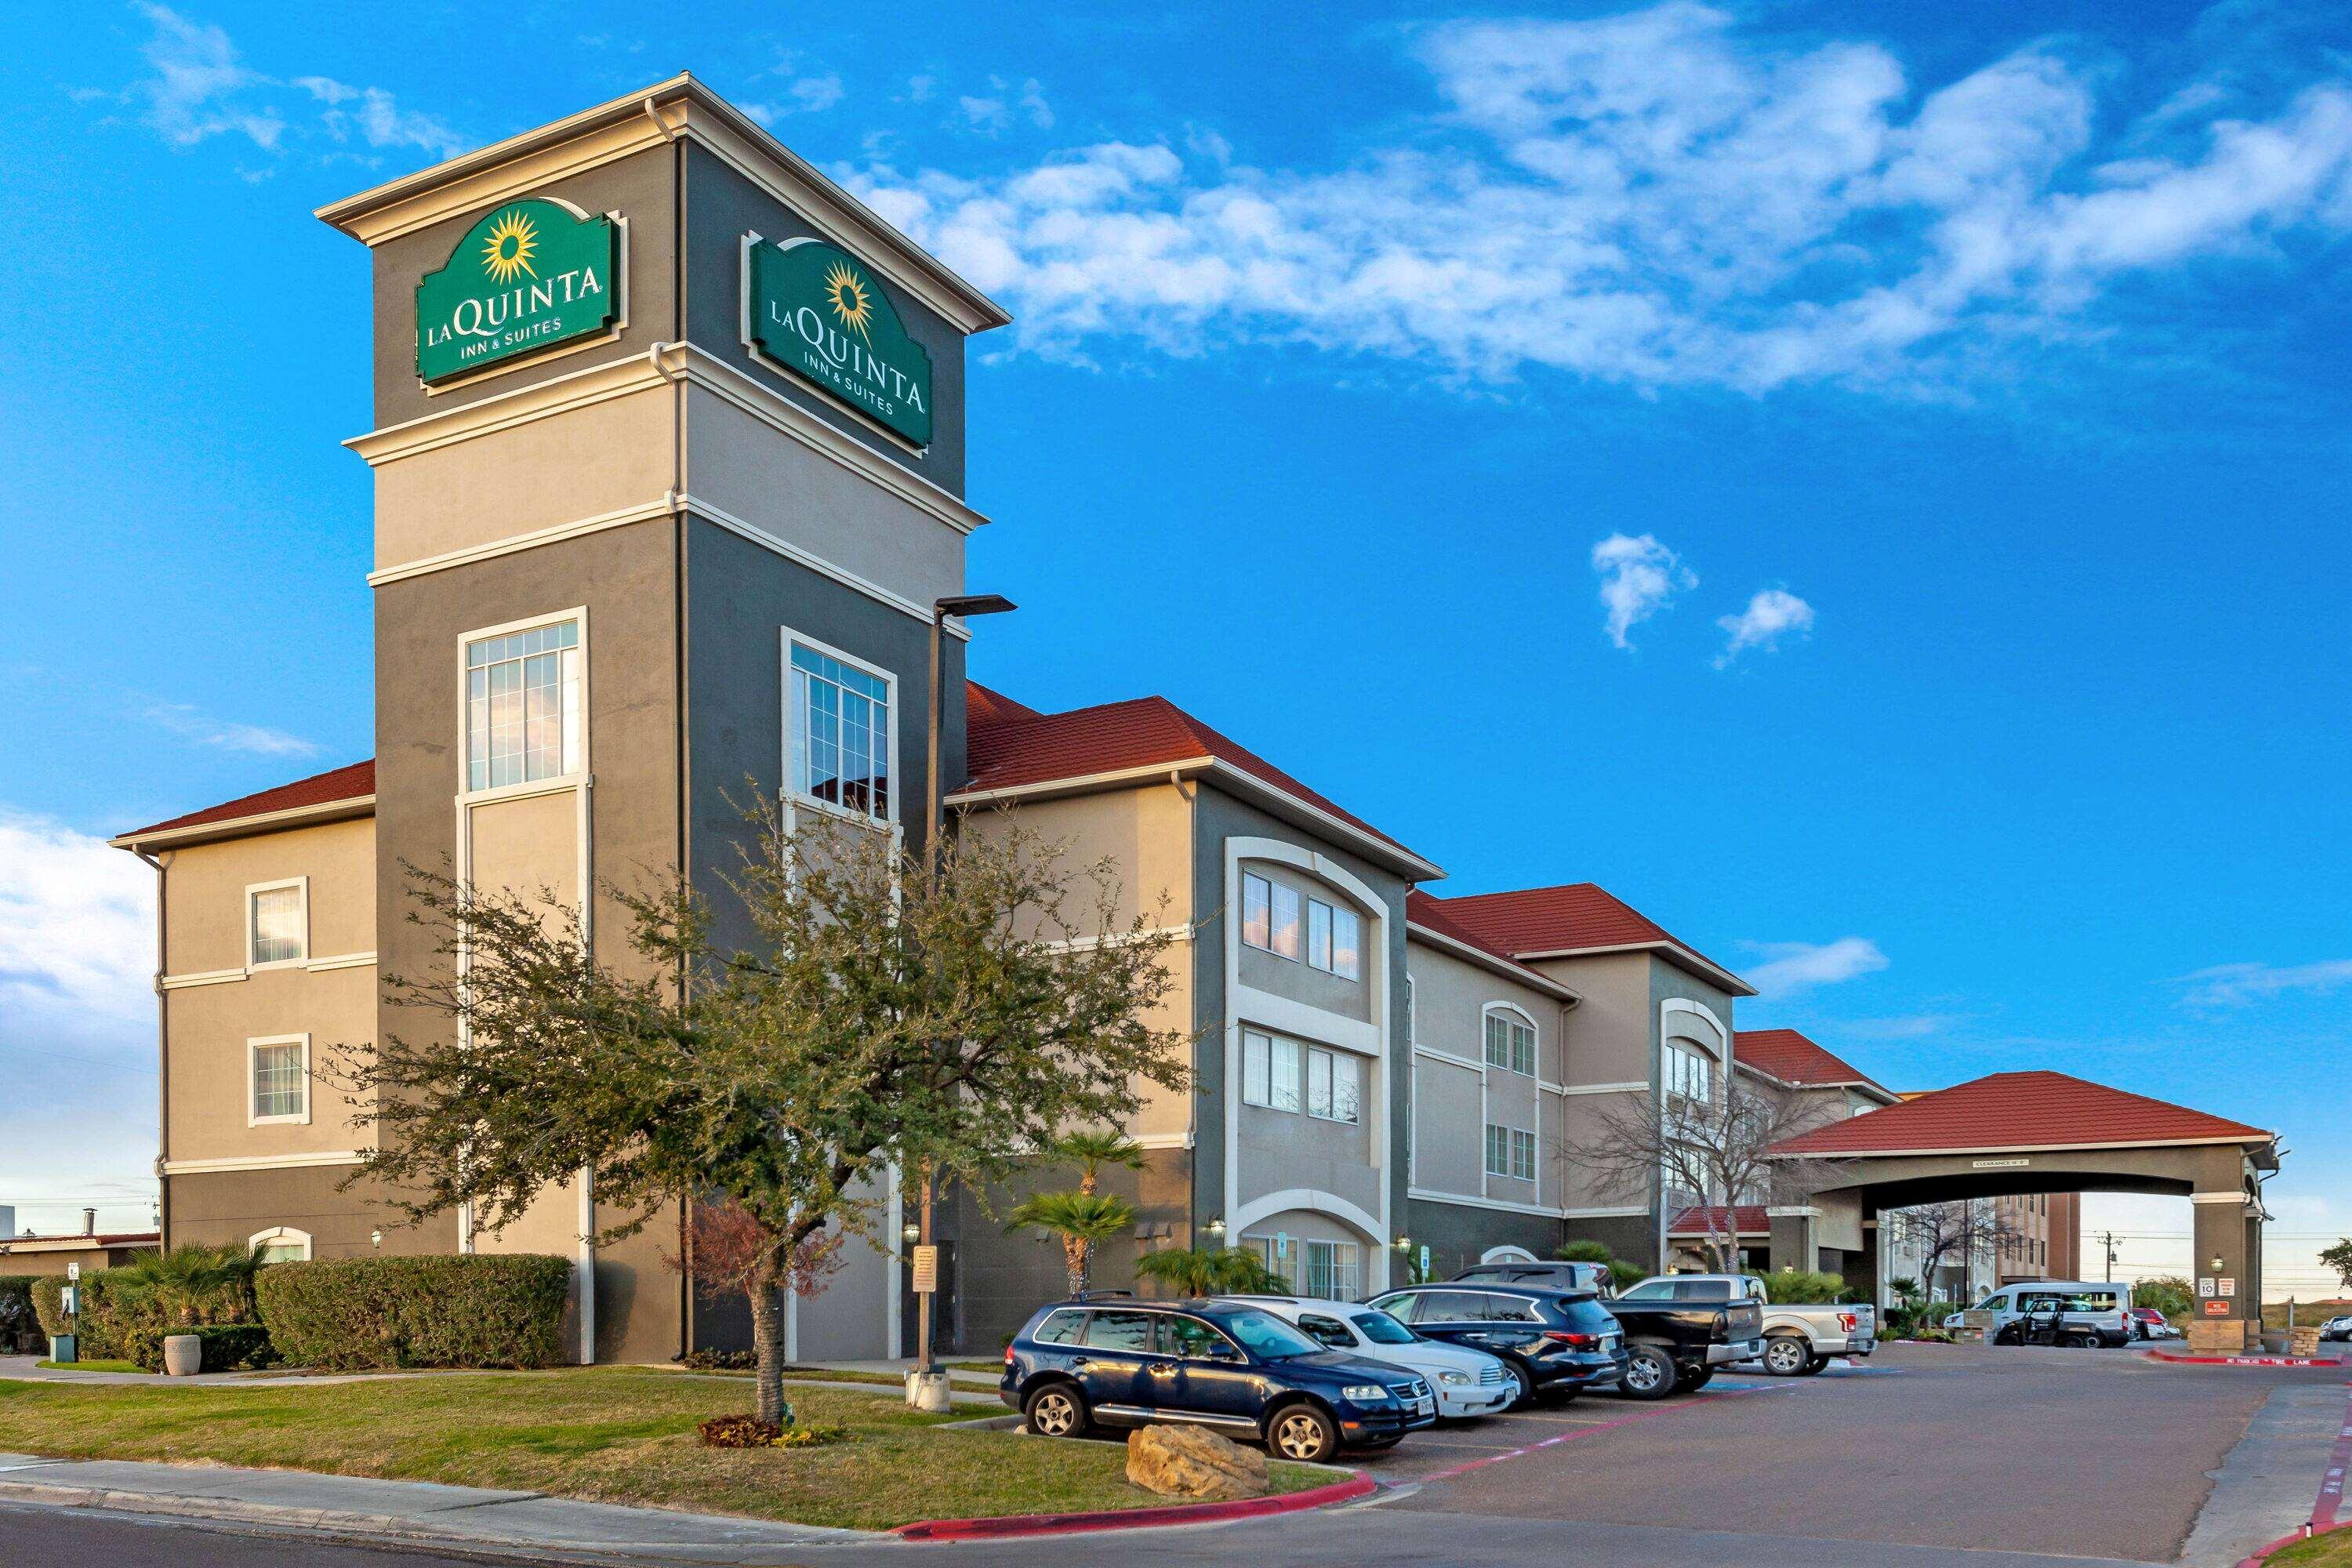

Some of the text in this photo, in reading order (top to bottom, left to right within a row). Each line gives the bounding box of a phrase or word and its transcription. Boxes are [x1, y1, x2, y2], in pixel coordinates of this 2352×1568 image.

[428, 266, 601, 347] LA QUINTA
[461, 318, 561, 359] INN & SUITES
[771, 299, 926, 414] LA QUINTA
[804, 351, 893, 416] INN & SUITES
